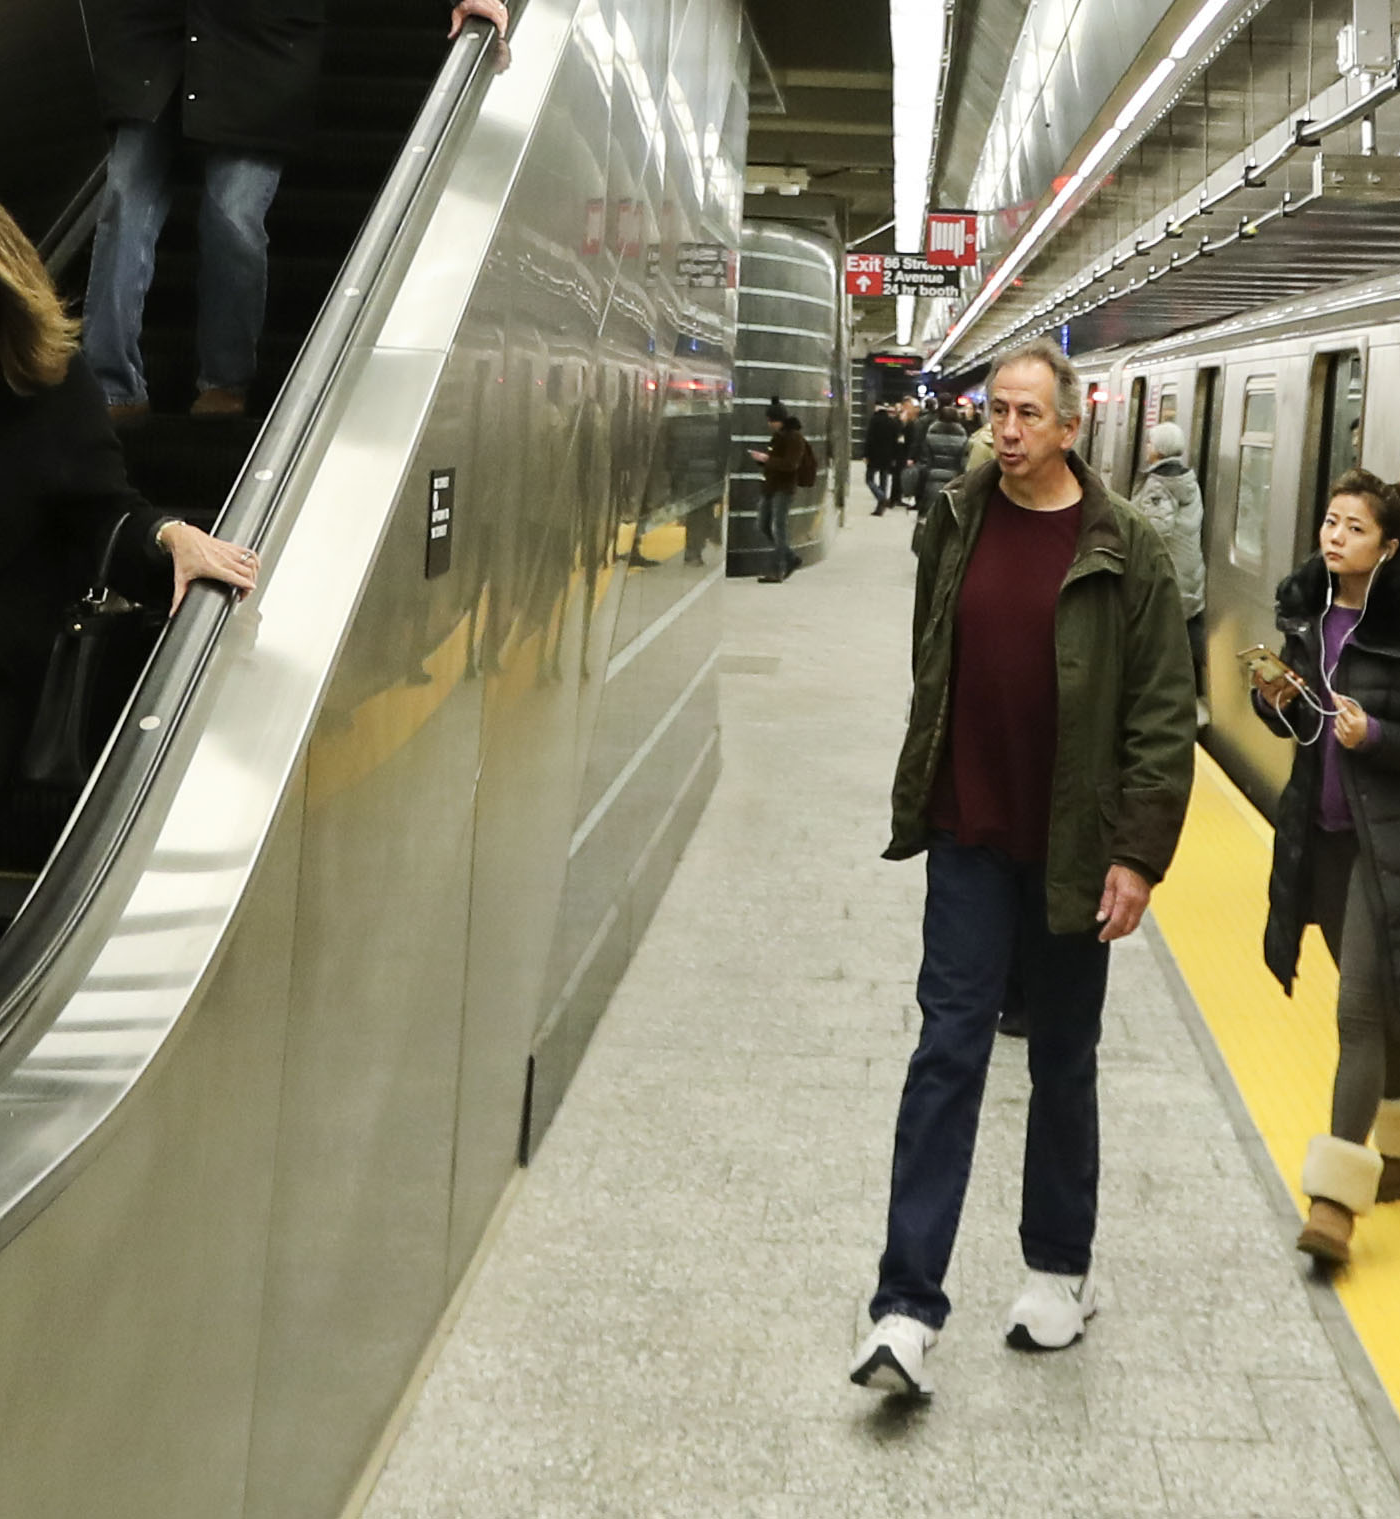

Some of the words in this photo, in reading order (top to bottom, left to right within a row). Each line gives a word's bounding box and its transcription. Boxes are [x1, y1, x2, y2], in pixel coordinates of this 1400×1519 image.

[846, 256, 882, 272] Exit
[902, 257, 944, 271] Stre
[884, 271, 892, 282] 2
[895, 270, 944, 283] Avenue
[883, 284, 899, 296] 24
[901, 284, 917, 295] hr
[920, 285, 958, 296] booth
